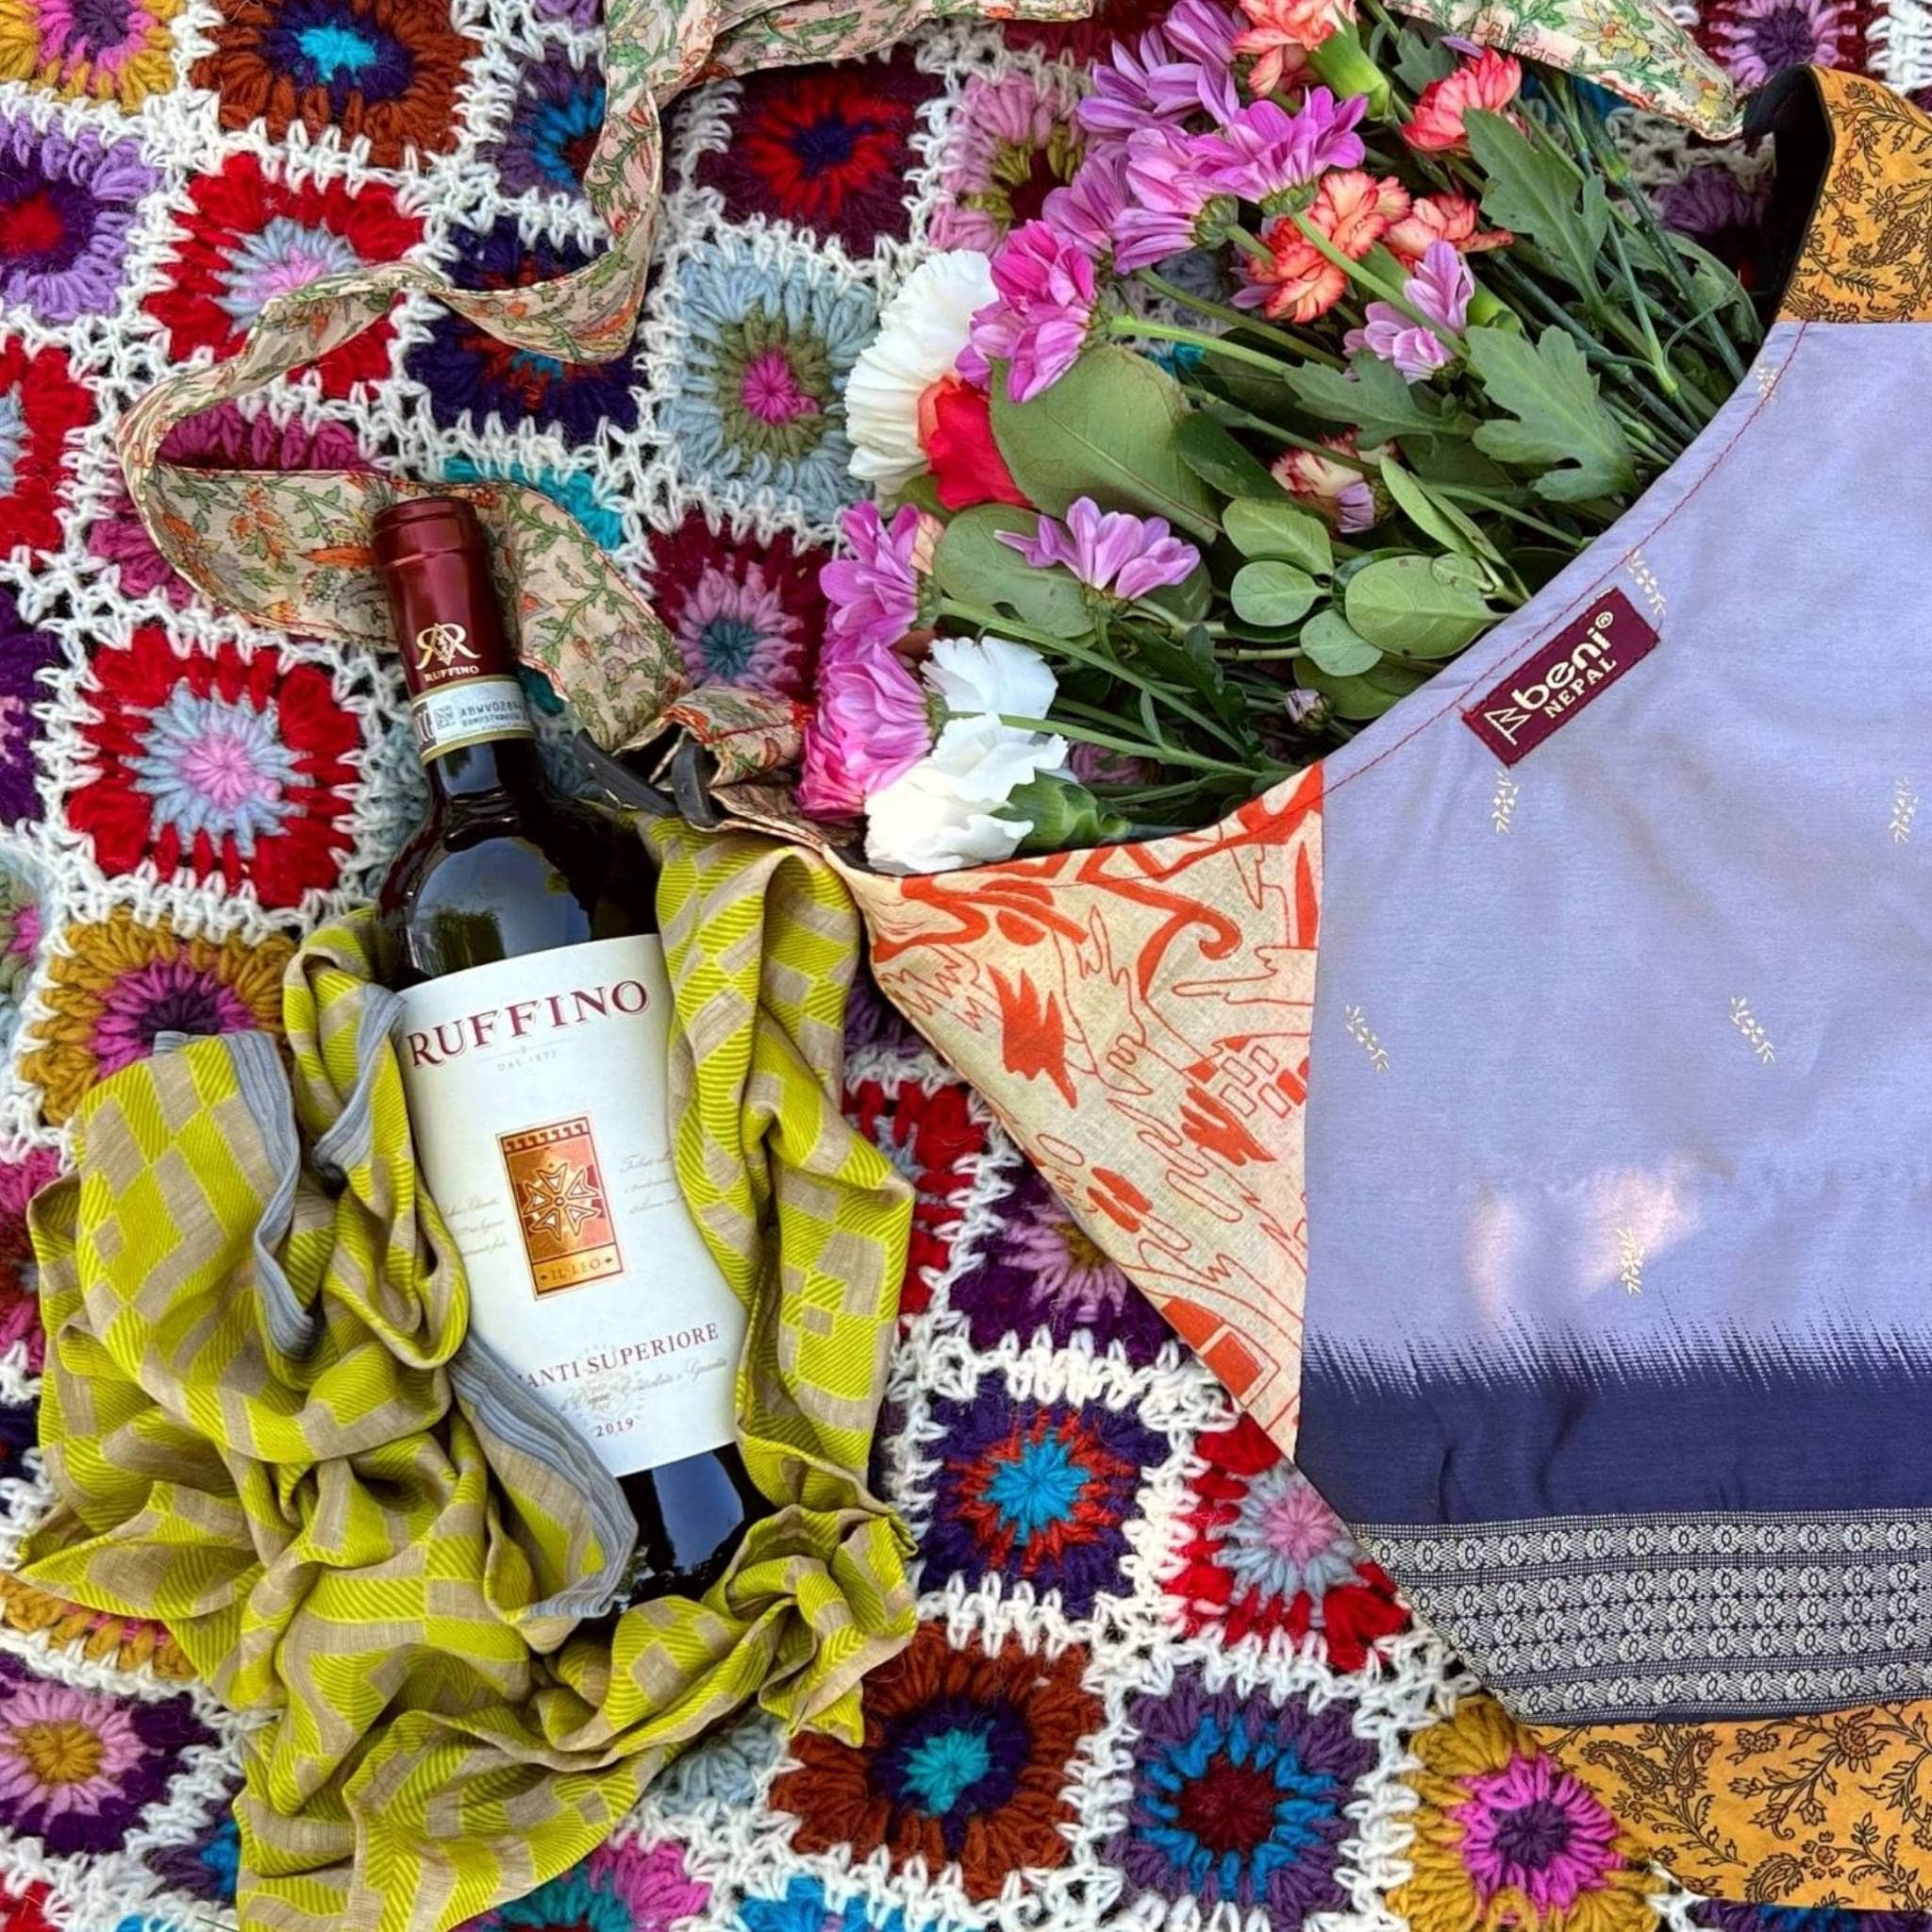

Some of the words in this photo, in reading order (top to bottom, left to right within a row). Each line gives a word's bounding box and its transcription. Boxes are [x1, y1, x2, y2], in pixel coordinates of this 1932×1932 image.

[425, 665, 479, 681] RUFFINO
[1544, 658, 1617, 718] NEPAL
[408, 979, 648, 1067] RUFFINO
[520, 1360, 579, 1390] ANTI
[587, 1323, 720, 1374] SUPERIORE
[595, 1418, 635, 1438] 2019
